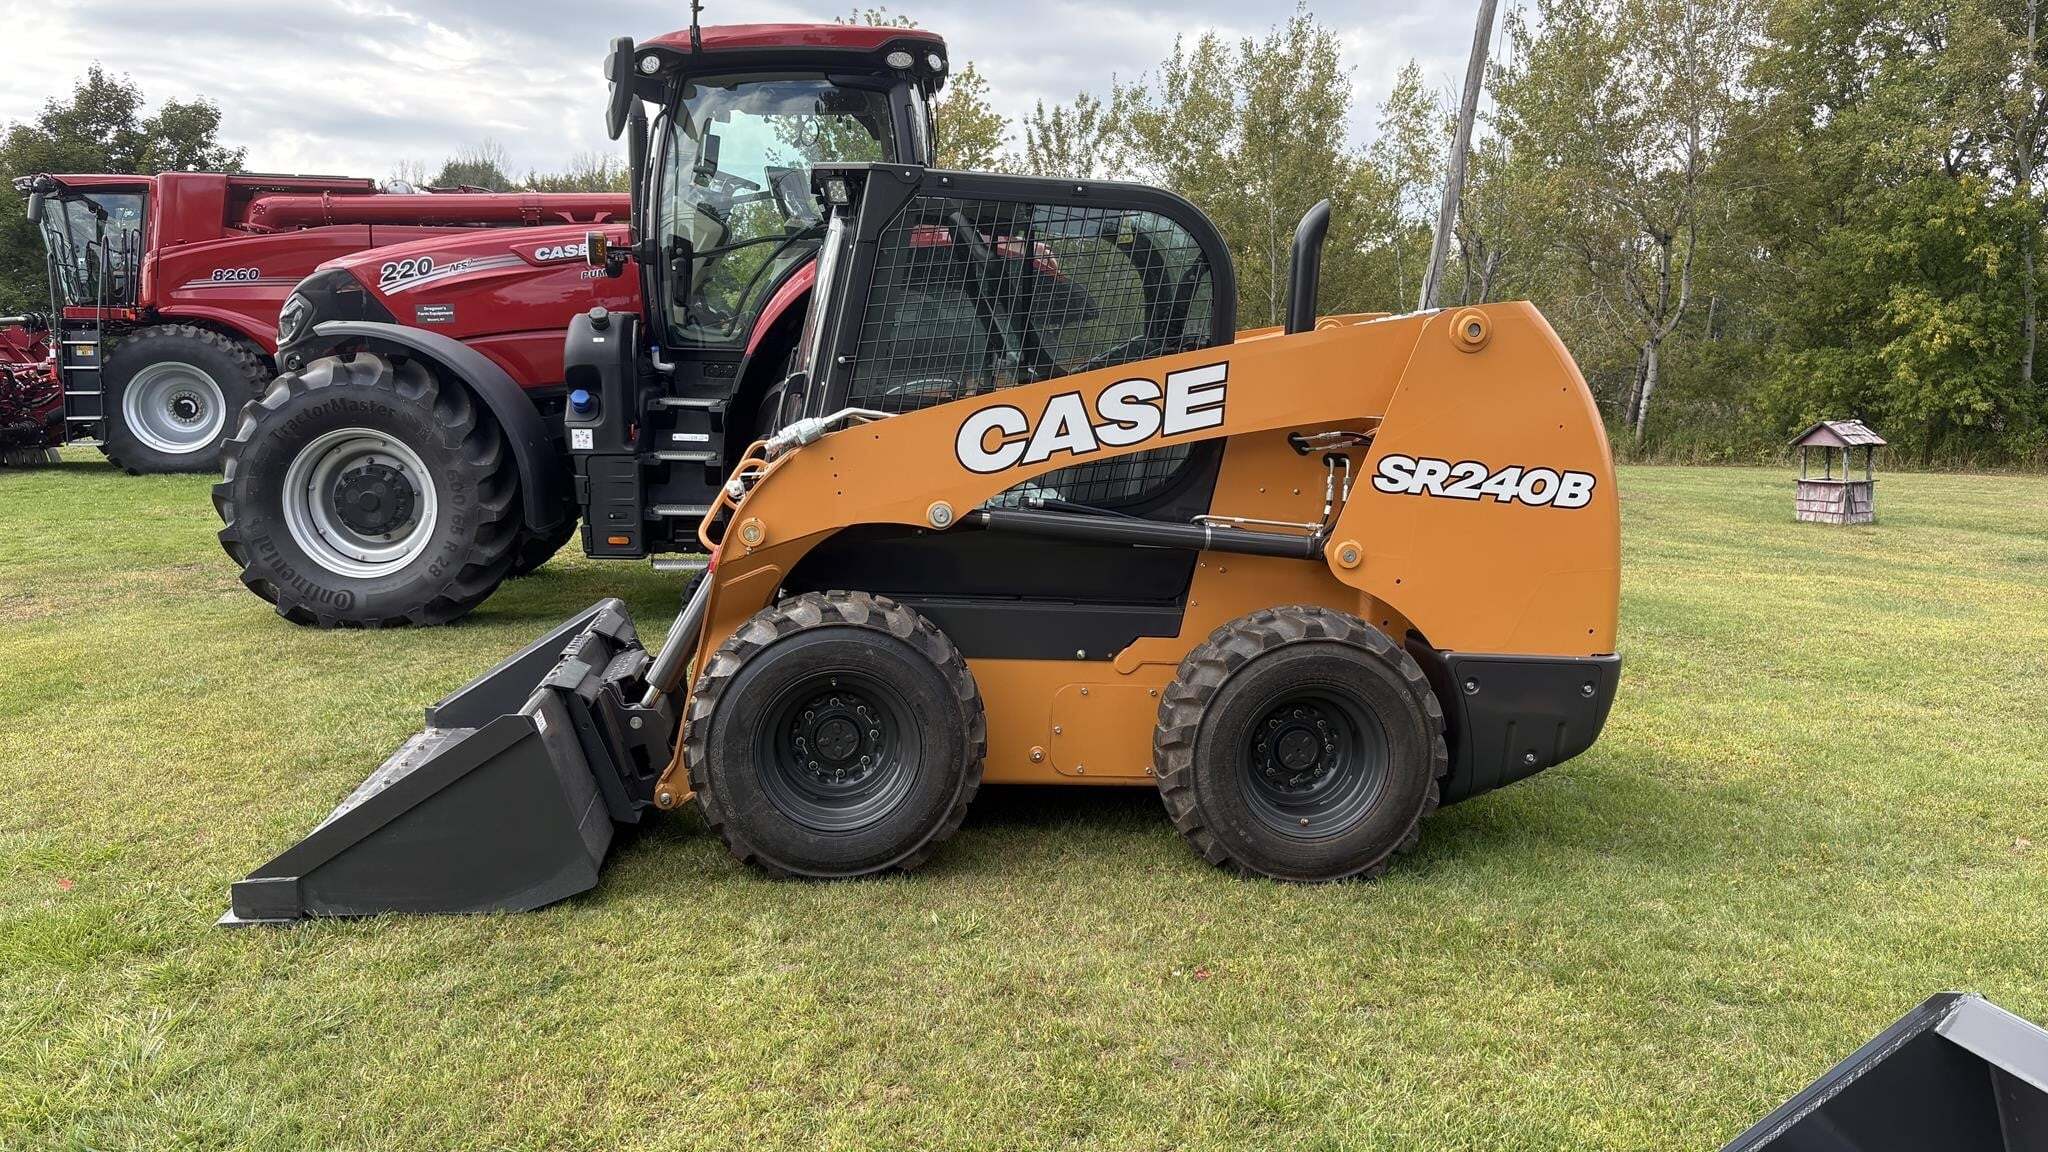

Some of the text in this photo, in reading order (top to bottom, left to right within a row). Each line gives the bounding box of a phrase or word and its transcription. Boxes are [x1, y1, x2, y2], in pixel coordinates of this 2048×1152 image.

[211, 267, 260, 281] 8260
[382, 256, 434, 283] 220
[580, 268, 608, 280] PUM
[270, 398, 397, 440] TractorMaster
[955, 360, 1229, 474] CASE
[1372, 454, 1597, 509] SR240B
[255, 535, 356, 612] Continental
